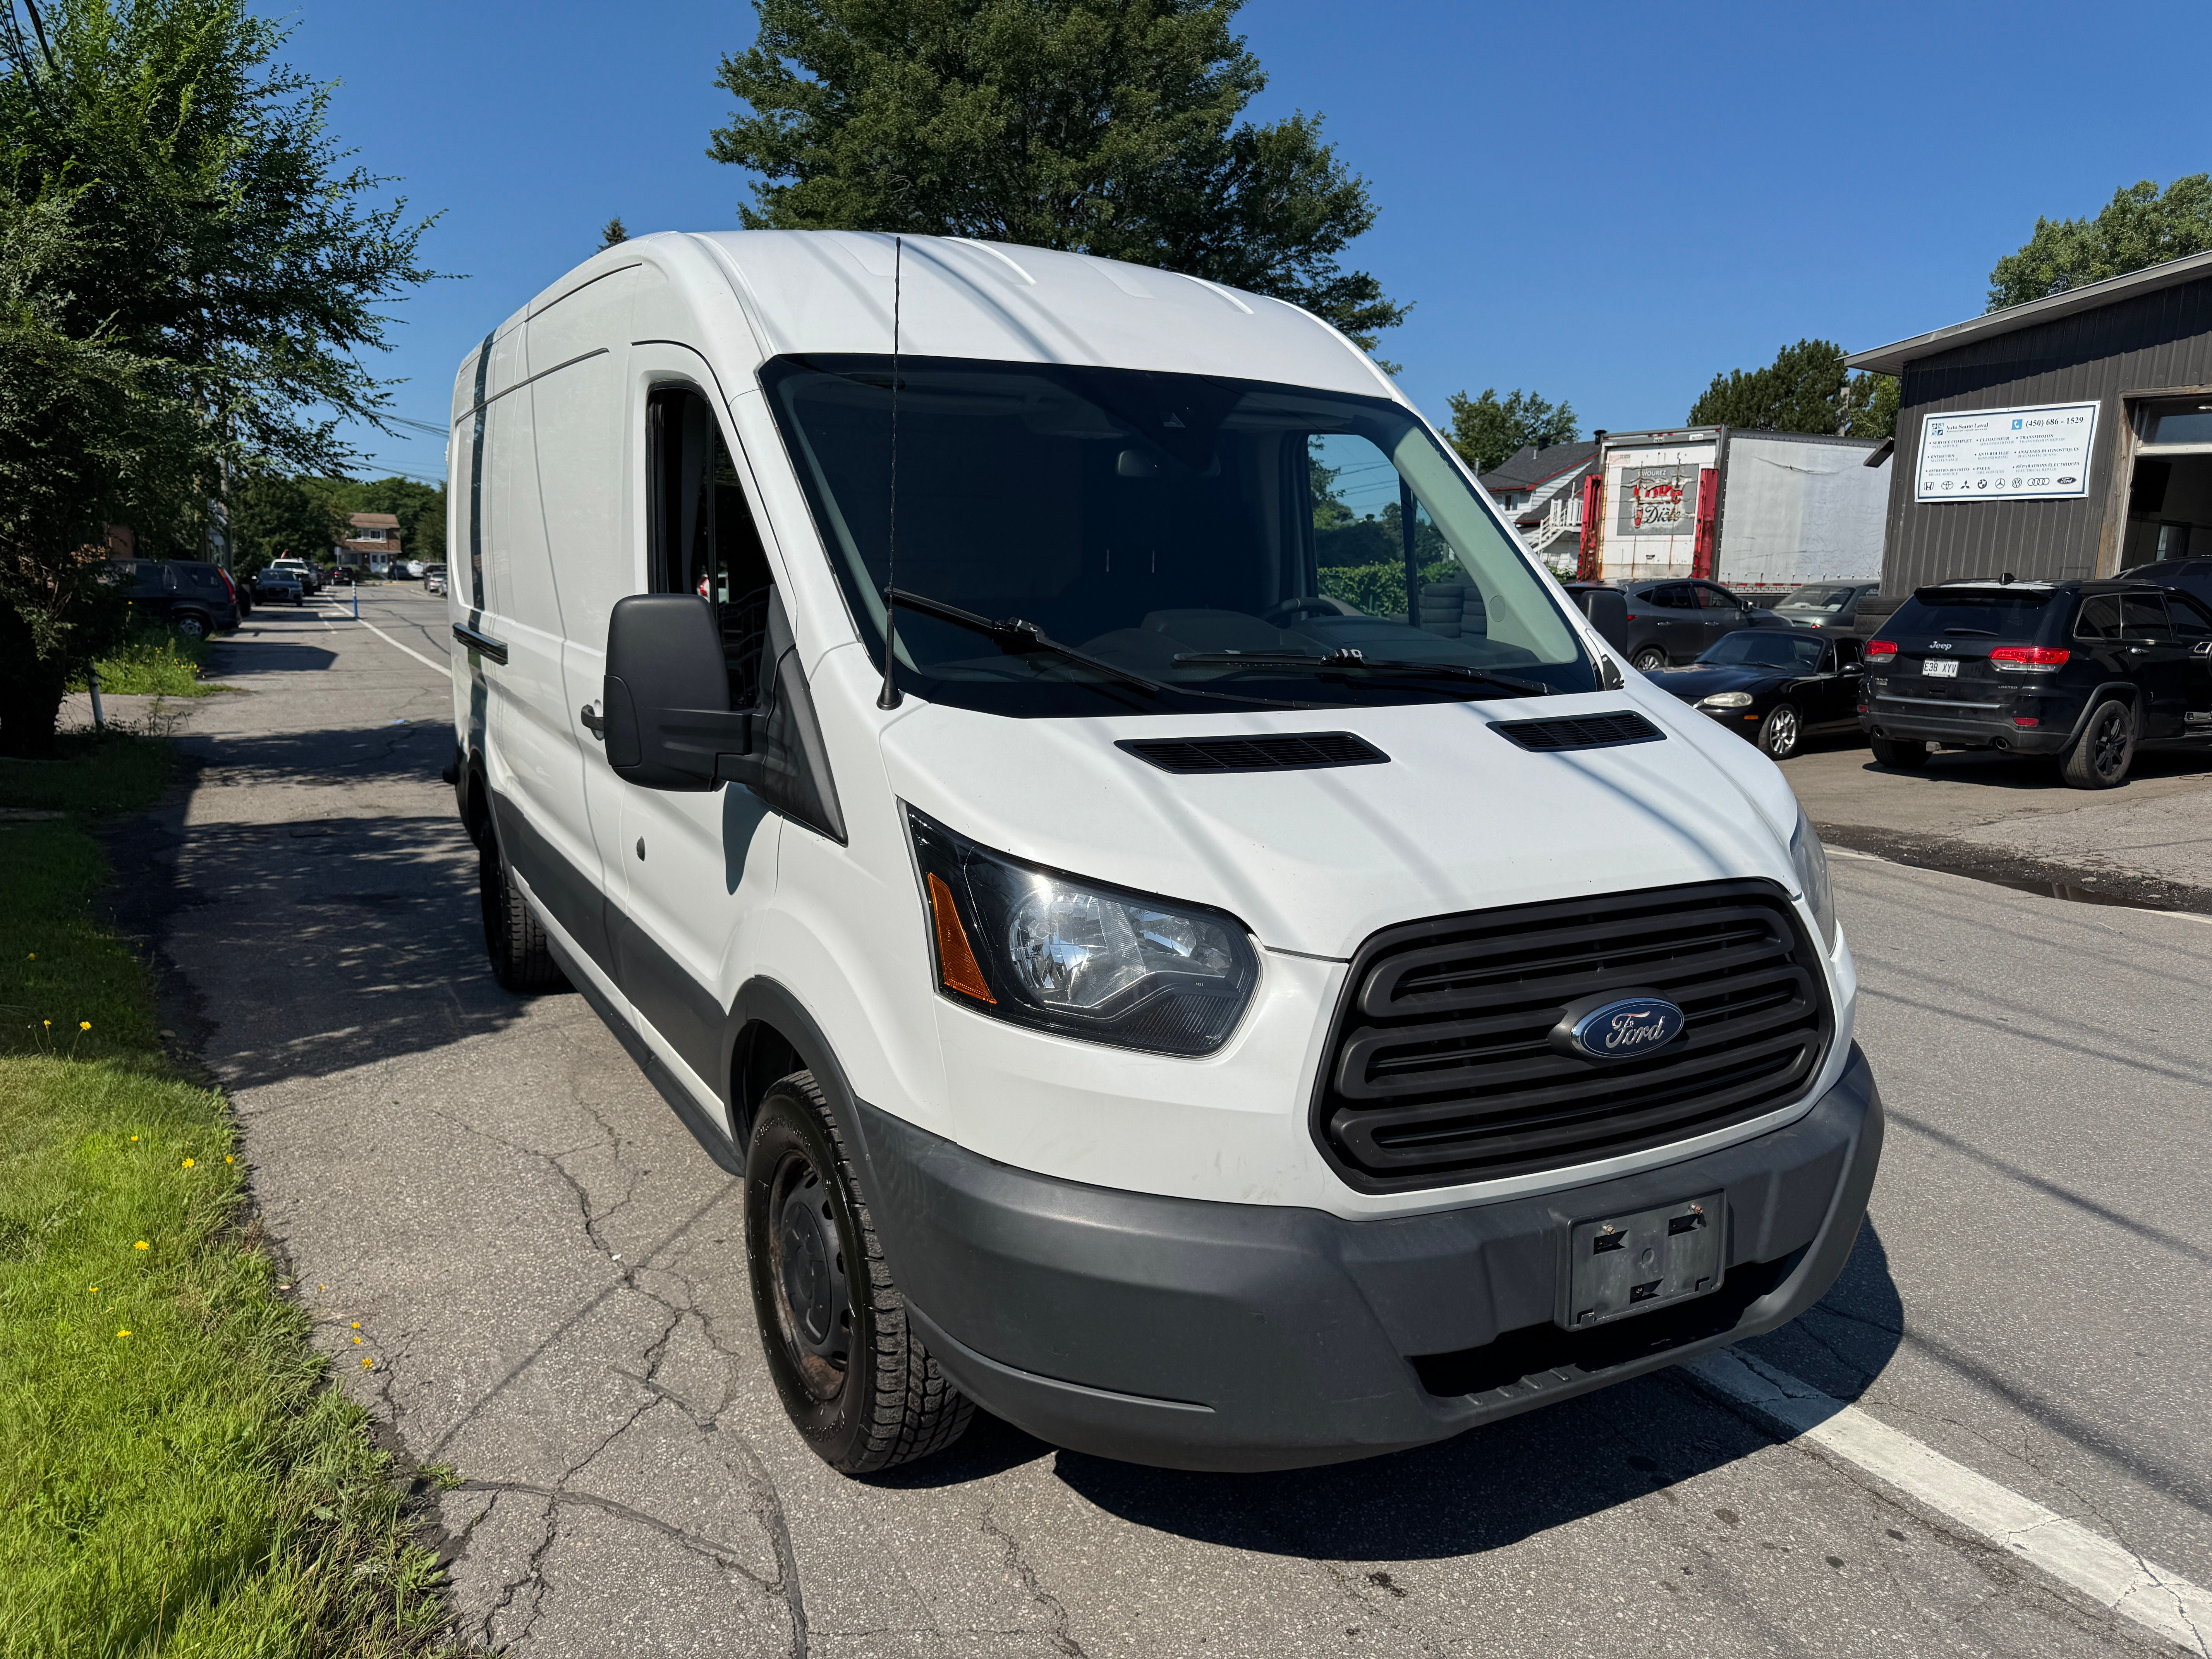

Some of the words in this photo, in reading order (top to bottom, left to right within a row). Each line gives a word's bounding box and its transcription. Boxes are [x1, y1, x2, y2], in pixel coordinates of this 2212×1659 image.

[2026, 419, 2044, 428] (450)
[1929, 641, 1952, 651] Jeep
[1924, 663, 1938, 672] E38
[1942, 663, 1956, 673] XYV
[1605, 1010, 1665, 1048] Ford
